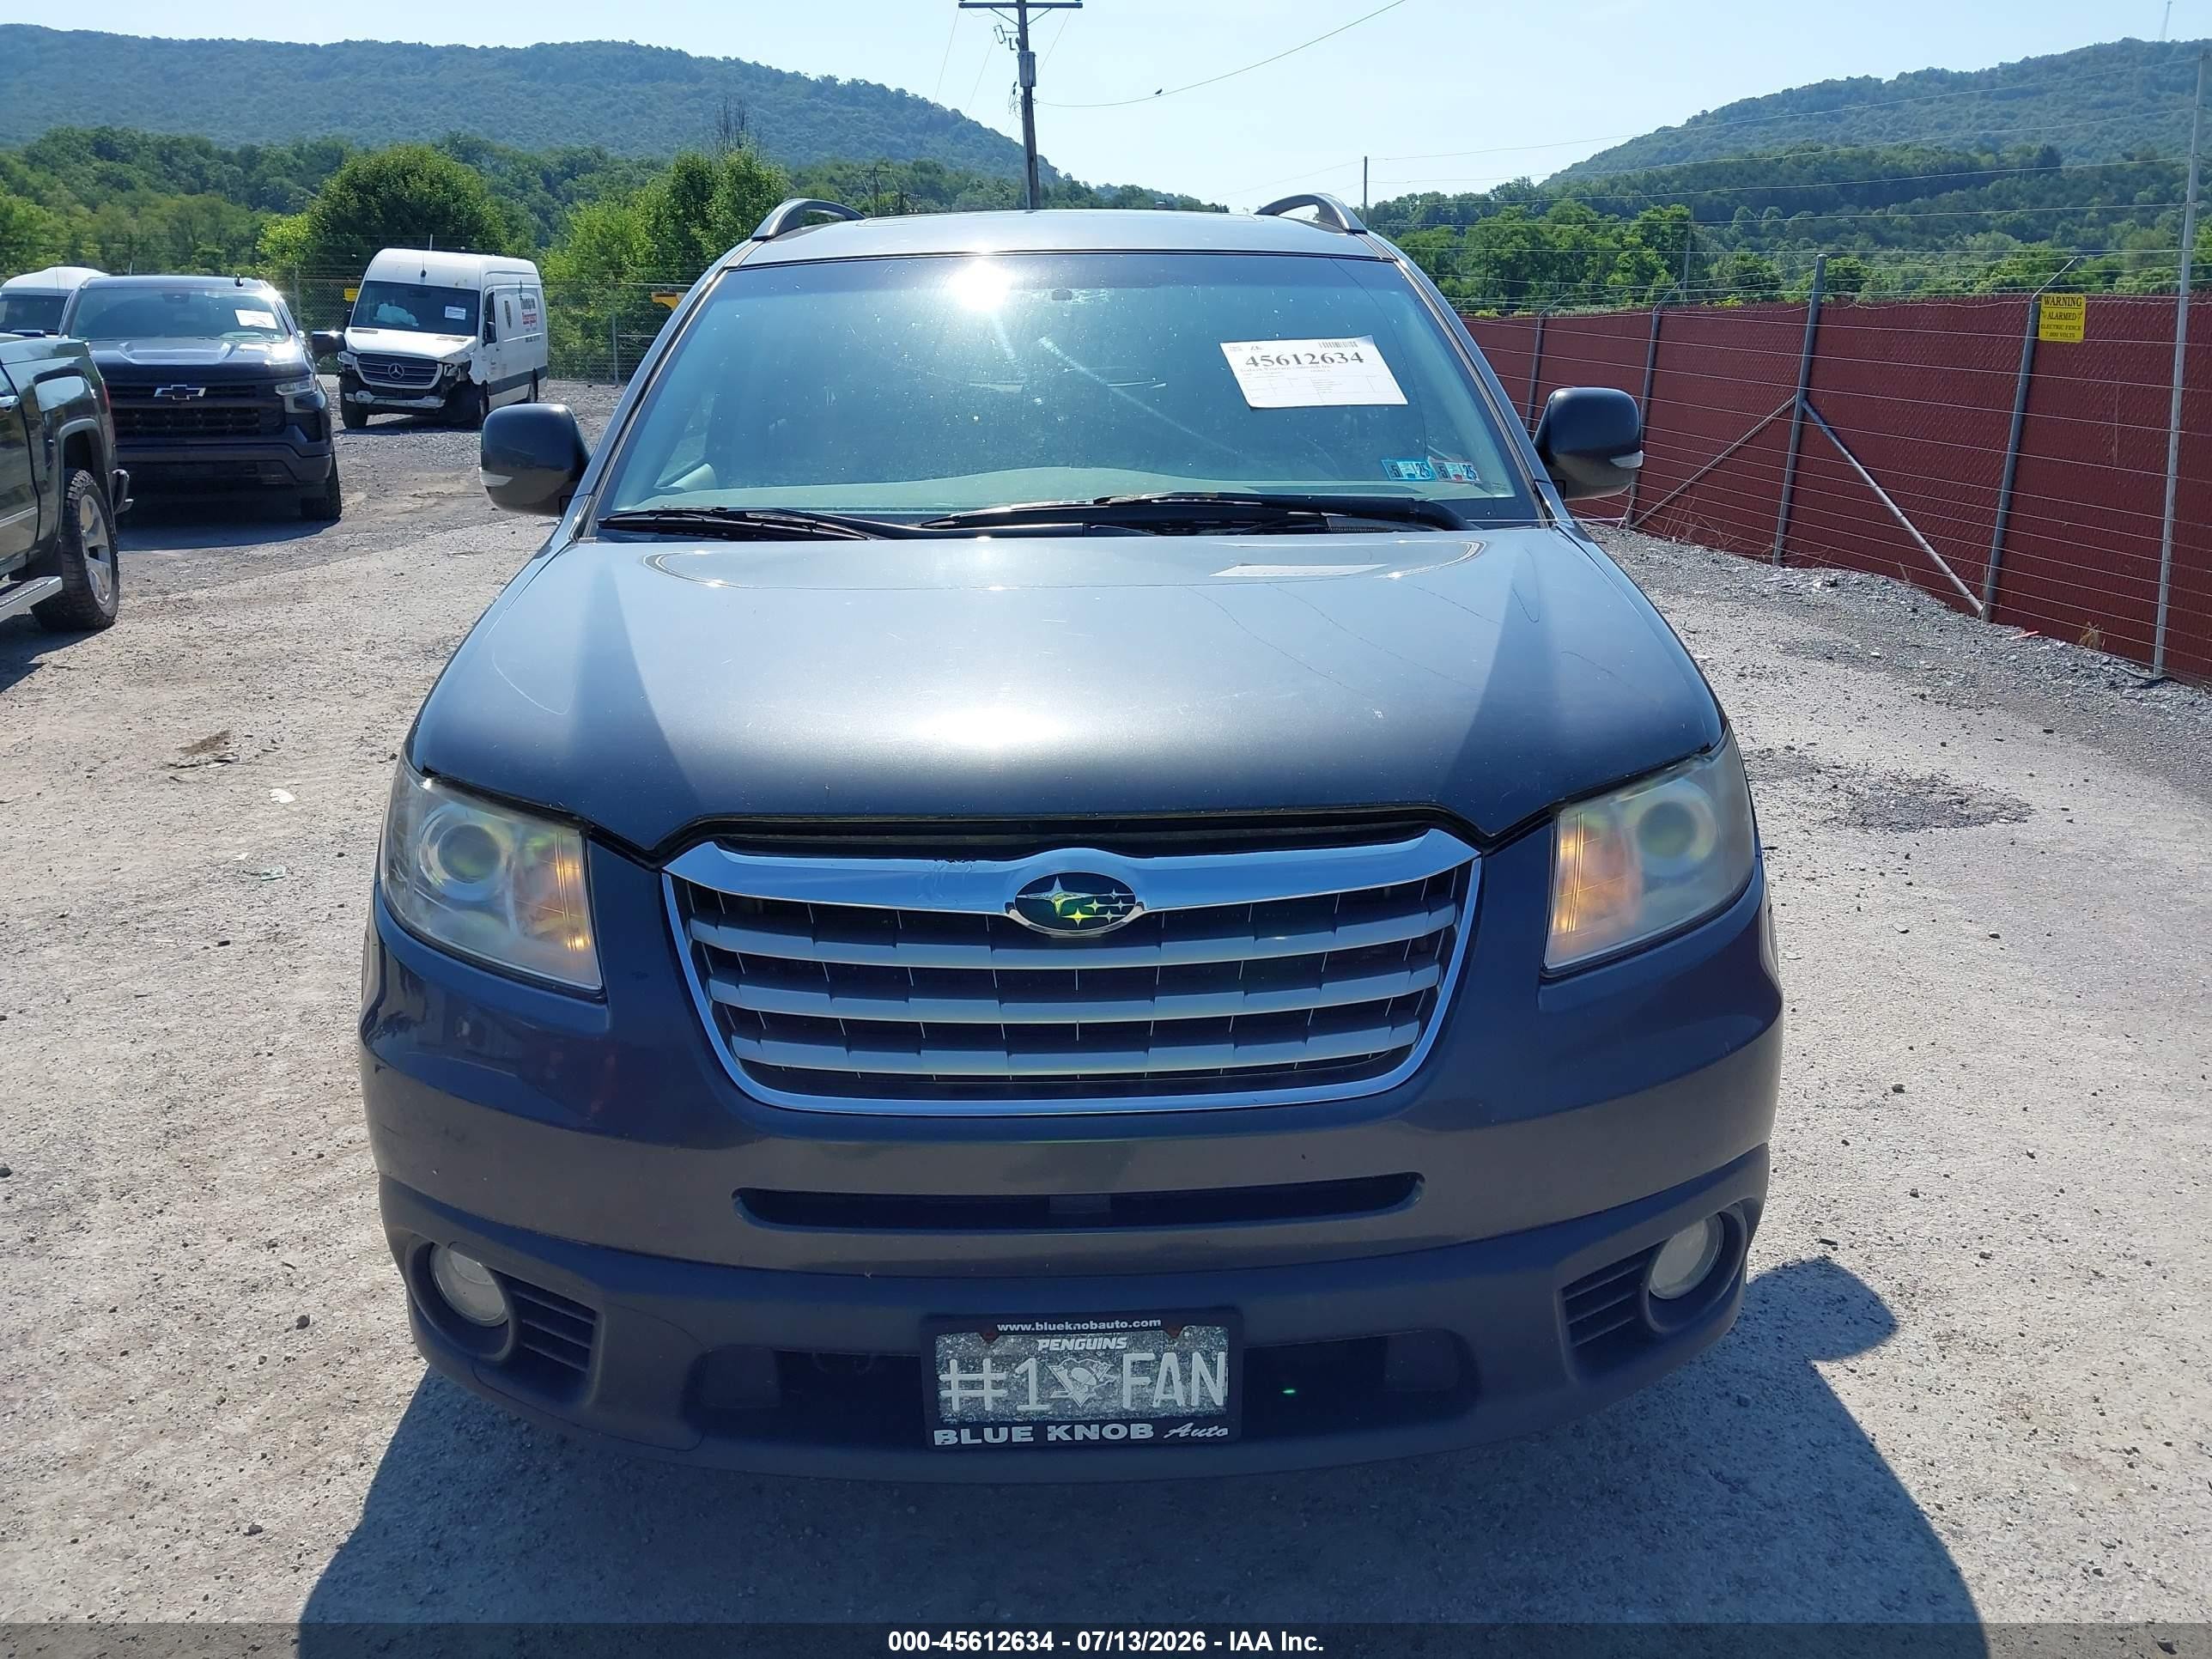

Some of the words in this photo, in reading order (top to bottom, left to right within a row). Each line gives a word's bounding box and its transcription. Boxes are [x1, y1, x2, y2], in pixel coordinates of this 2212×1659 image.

[2044, 296, 2082, 307] WARNING
[2047, 312, 2076, 320] ALARMED
[1245, 351, 1364, 368] 45612634
[1415, 463, 1431, 478] 25
[1463, 465, 1478, 480] 25
[997, 1318, 1161, 1332] www.blueknobauto.com
[1036, 1337, 1128, 1352] PENGUINS
[1122, 1352, 1227, 1410] FAN
[933, 1425, 1034, 1446] BLUE
[1047, 1423, 1155, 1442] KNOB
[1164, 1422, 1230, 1439] Auto
